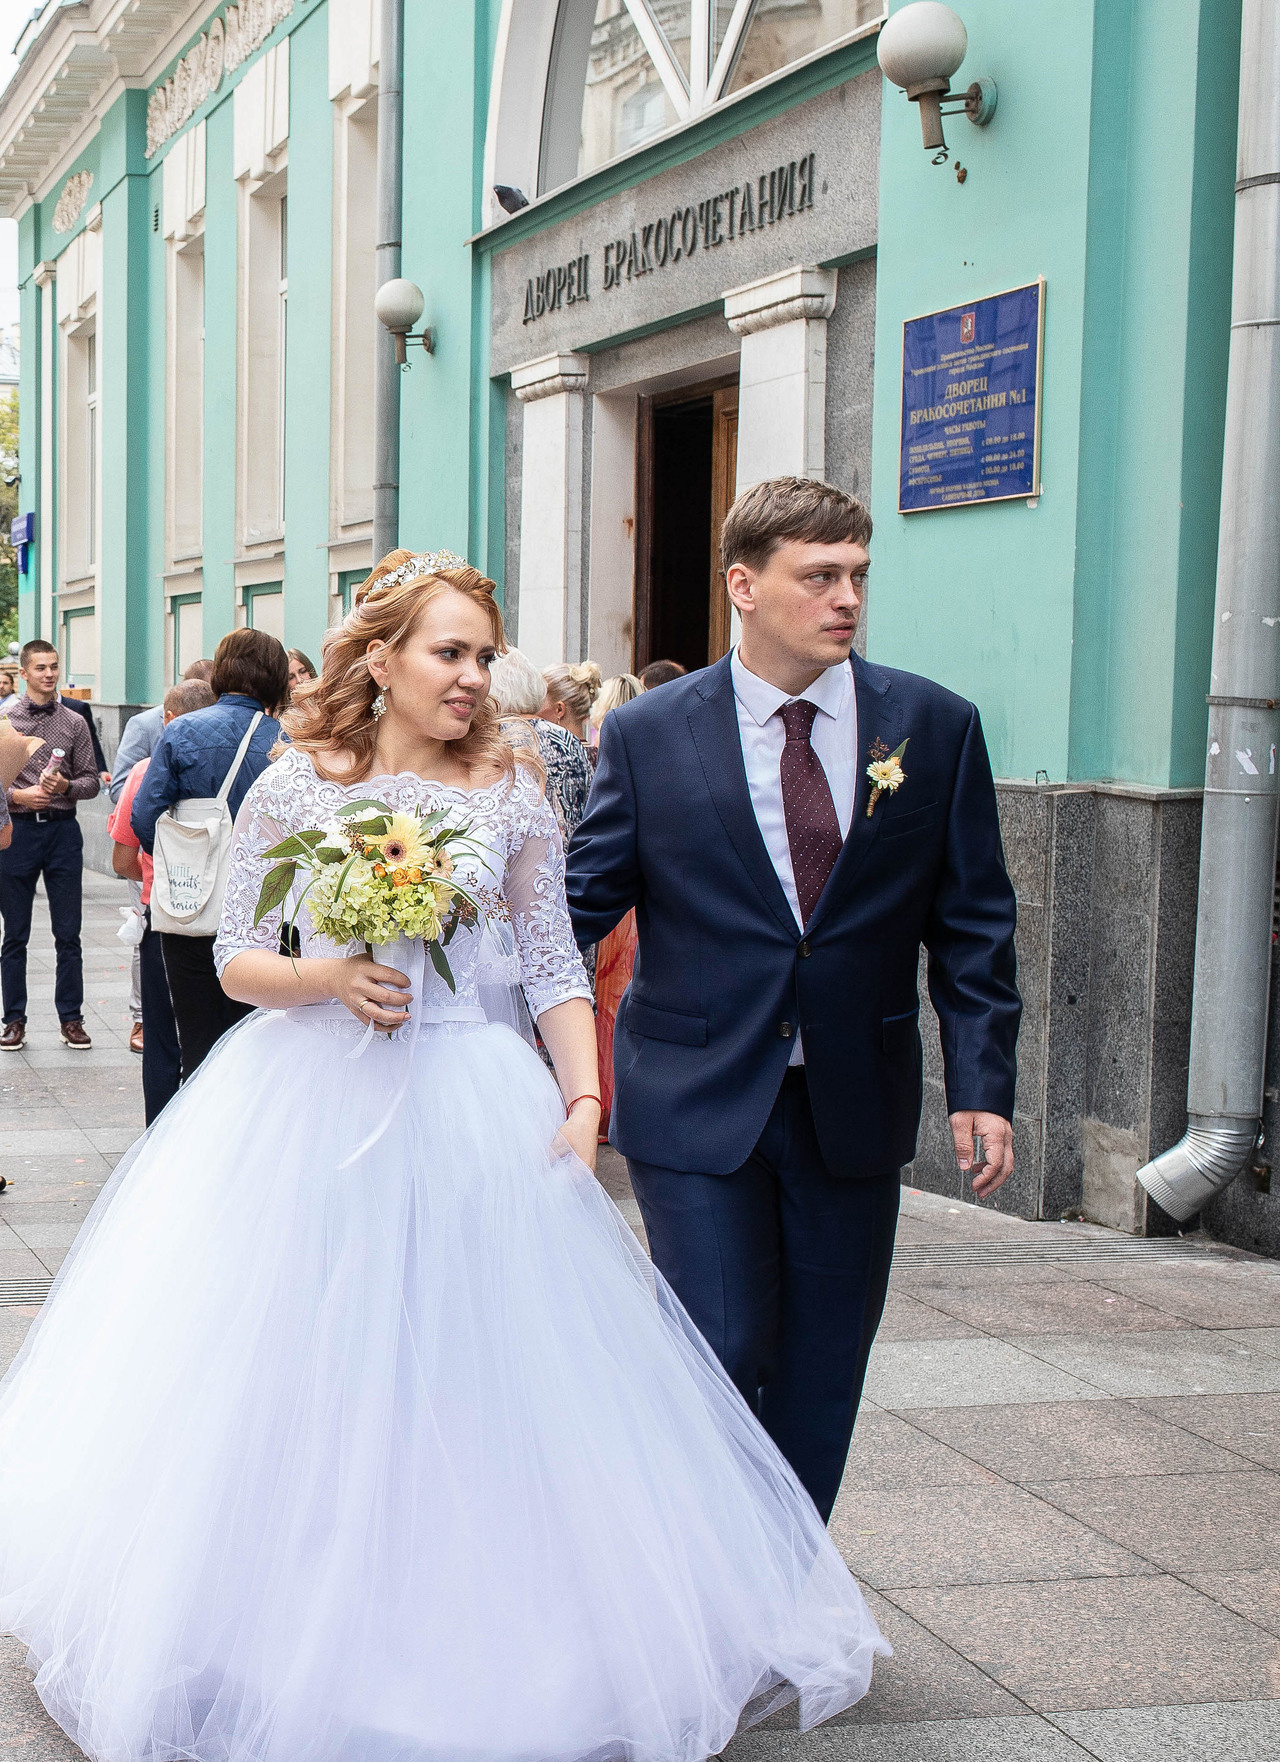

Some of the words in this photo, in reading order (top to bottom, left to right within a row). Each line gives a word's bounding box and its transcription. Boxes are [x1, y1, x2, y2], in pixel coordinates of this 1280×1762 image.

[523, 253, 590, 325] ДВОРЕЦ
[602, 152, 816, 291] БРАКОСОЧЕТАНИЯ
[910, 392, 1006, 424] БРАКОСОЧЕТАНИЯ
[1009, 388, 1027, 405] №1
[944, 376, 988, 400] ДВОРЕЦ
